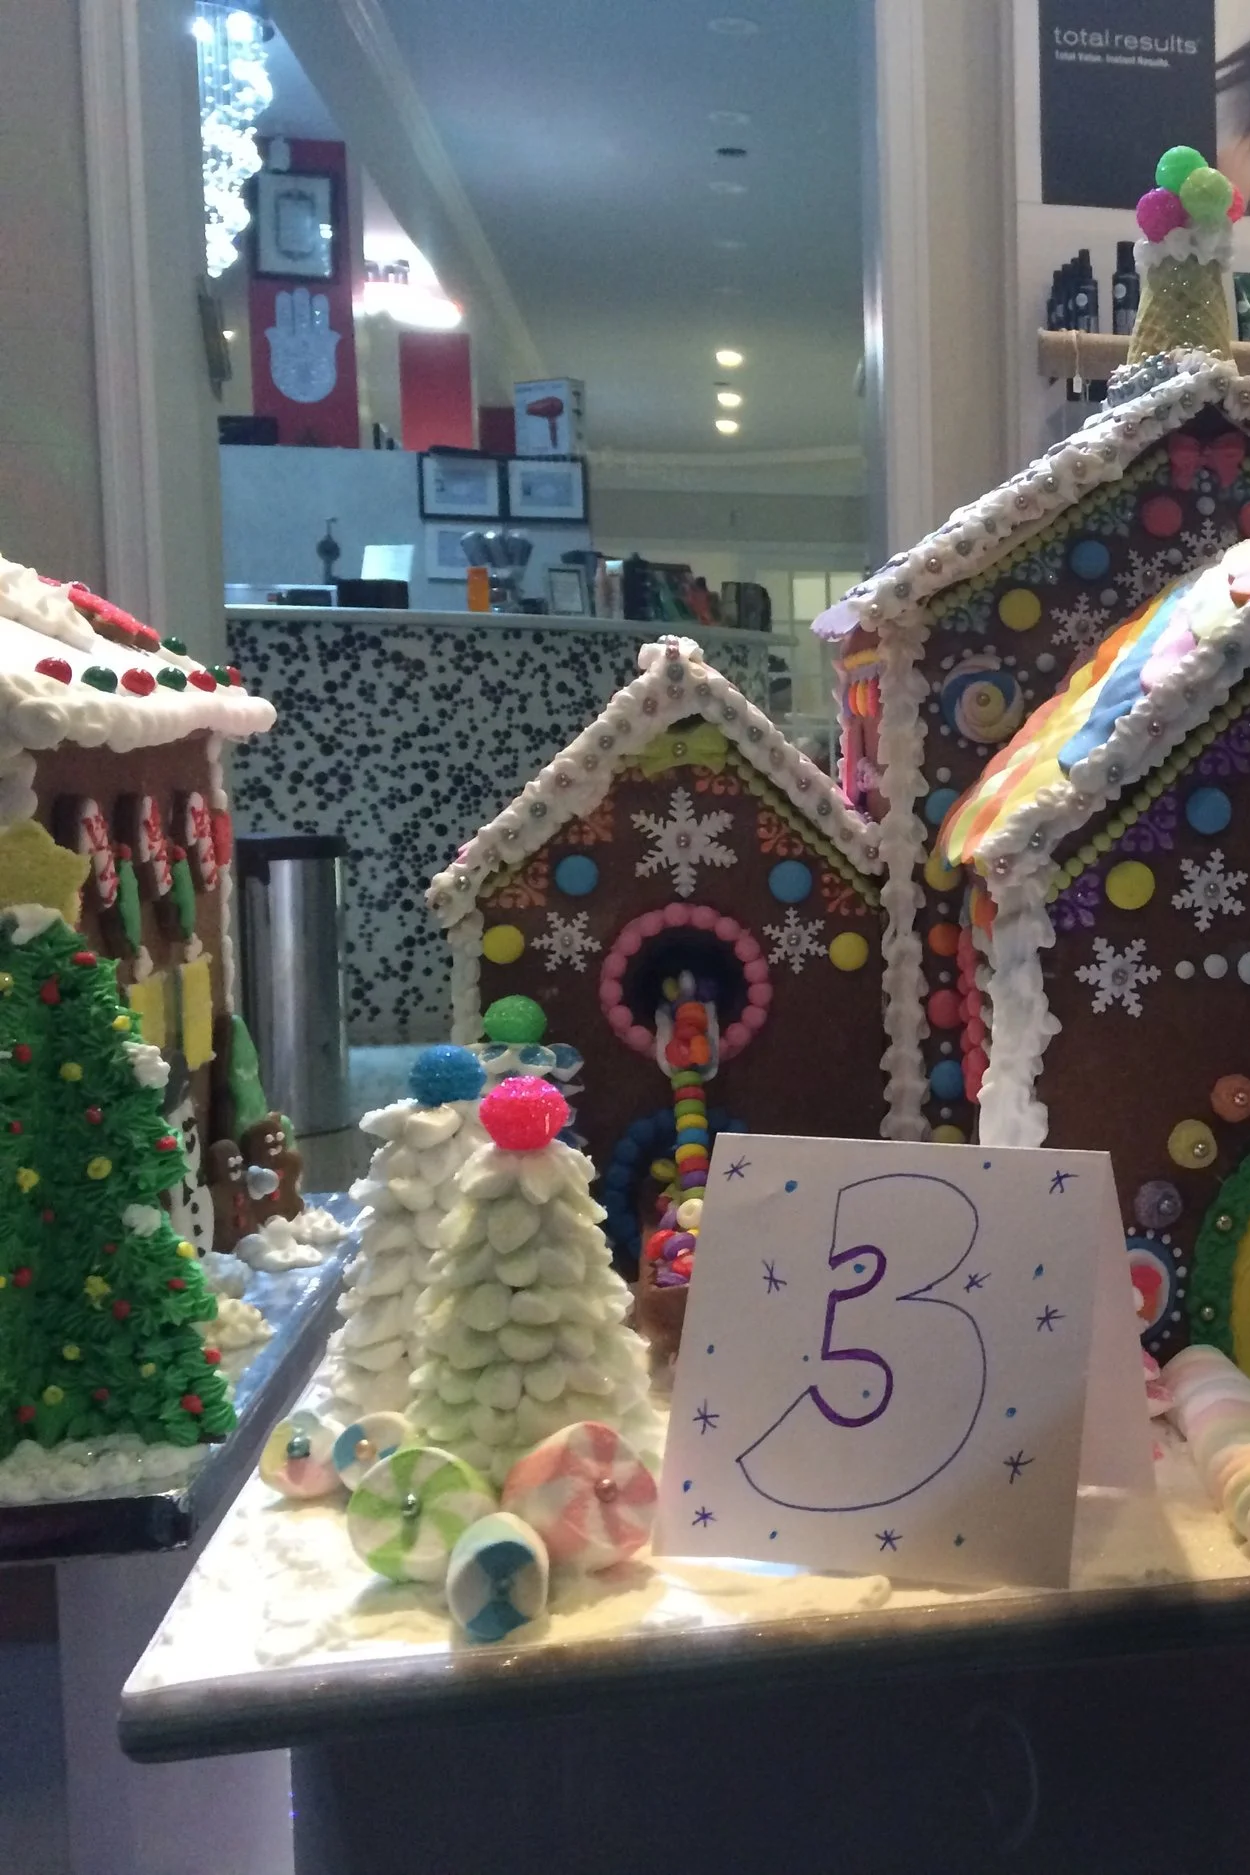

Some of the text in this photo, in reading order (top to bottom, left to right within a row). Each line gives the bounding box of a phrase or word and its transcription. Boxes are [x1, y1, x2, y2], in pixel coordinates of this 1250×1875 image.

[1053, 26, 1198, 55] total results
[735, 1173, 988, 1513] 3
